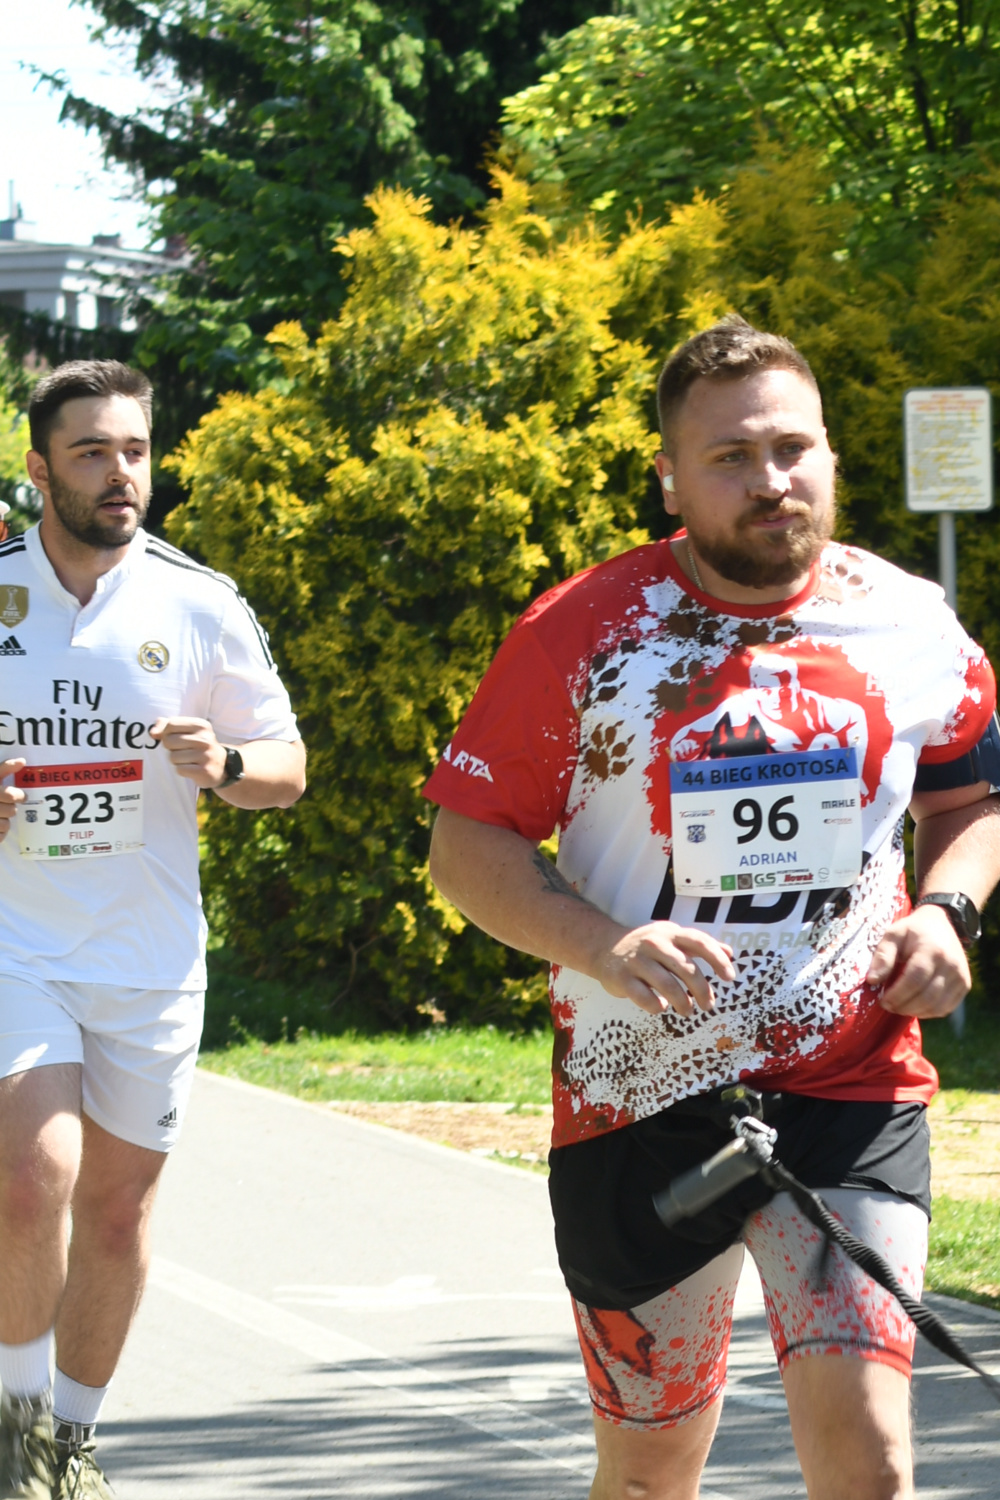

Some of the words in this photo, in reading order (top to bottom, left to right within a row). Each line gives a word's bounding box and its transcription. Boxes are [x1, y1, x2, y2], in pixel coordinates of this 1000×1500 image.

[52, 680, 103, 711] Fly
[22, 773, 36, 783] 44
[40, 771, 71, 783] BIEG
[74, 767, 137, 782] KROTOSA
[682, 771, 705, 786] 44
[710, 766, 752, 785] BIEG
[758, 758, 849, 781] KROTOSA
[44, 791, 114, 826] 323
[821, 799, 856, 810] MAHLE
[732, 795, 799, 845] 96
[69, 831, 95, 840] FILIP
[739, 851, 798, 867] ADRIAN
[754, 872, 776, 886] GS
[721, 931, 770, 950] DOG
